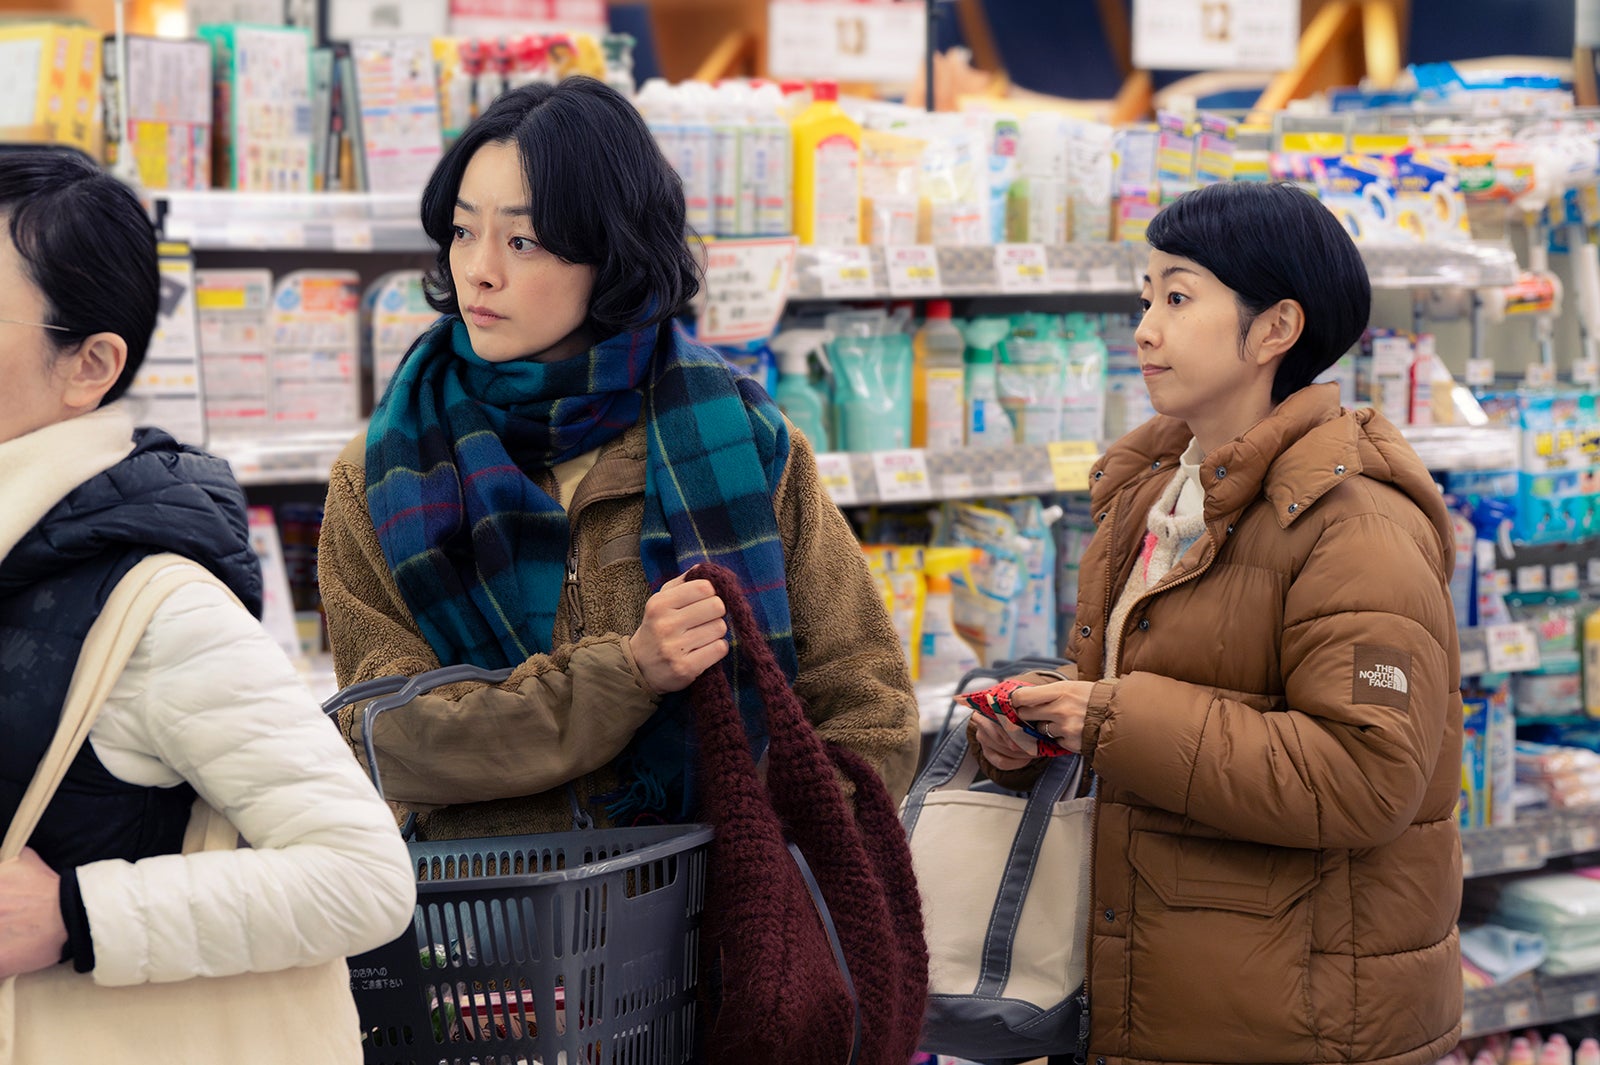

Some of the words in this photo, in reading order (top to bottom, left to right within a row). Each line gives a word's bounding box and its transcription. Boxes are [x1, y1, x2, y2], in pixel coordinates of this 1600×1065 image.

[1375, 664, 1394, 674] THE
[1359, 670, 1393, 681] NORTH
[1369, 678, 1393, 689] FACE
